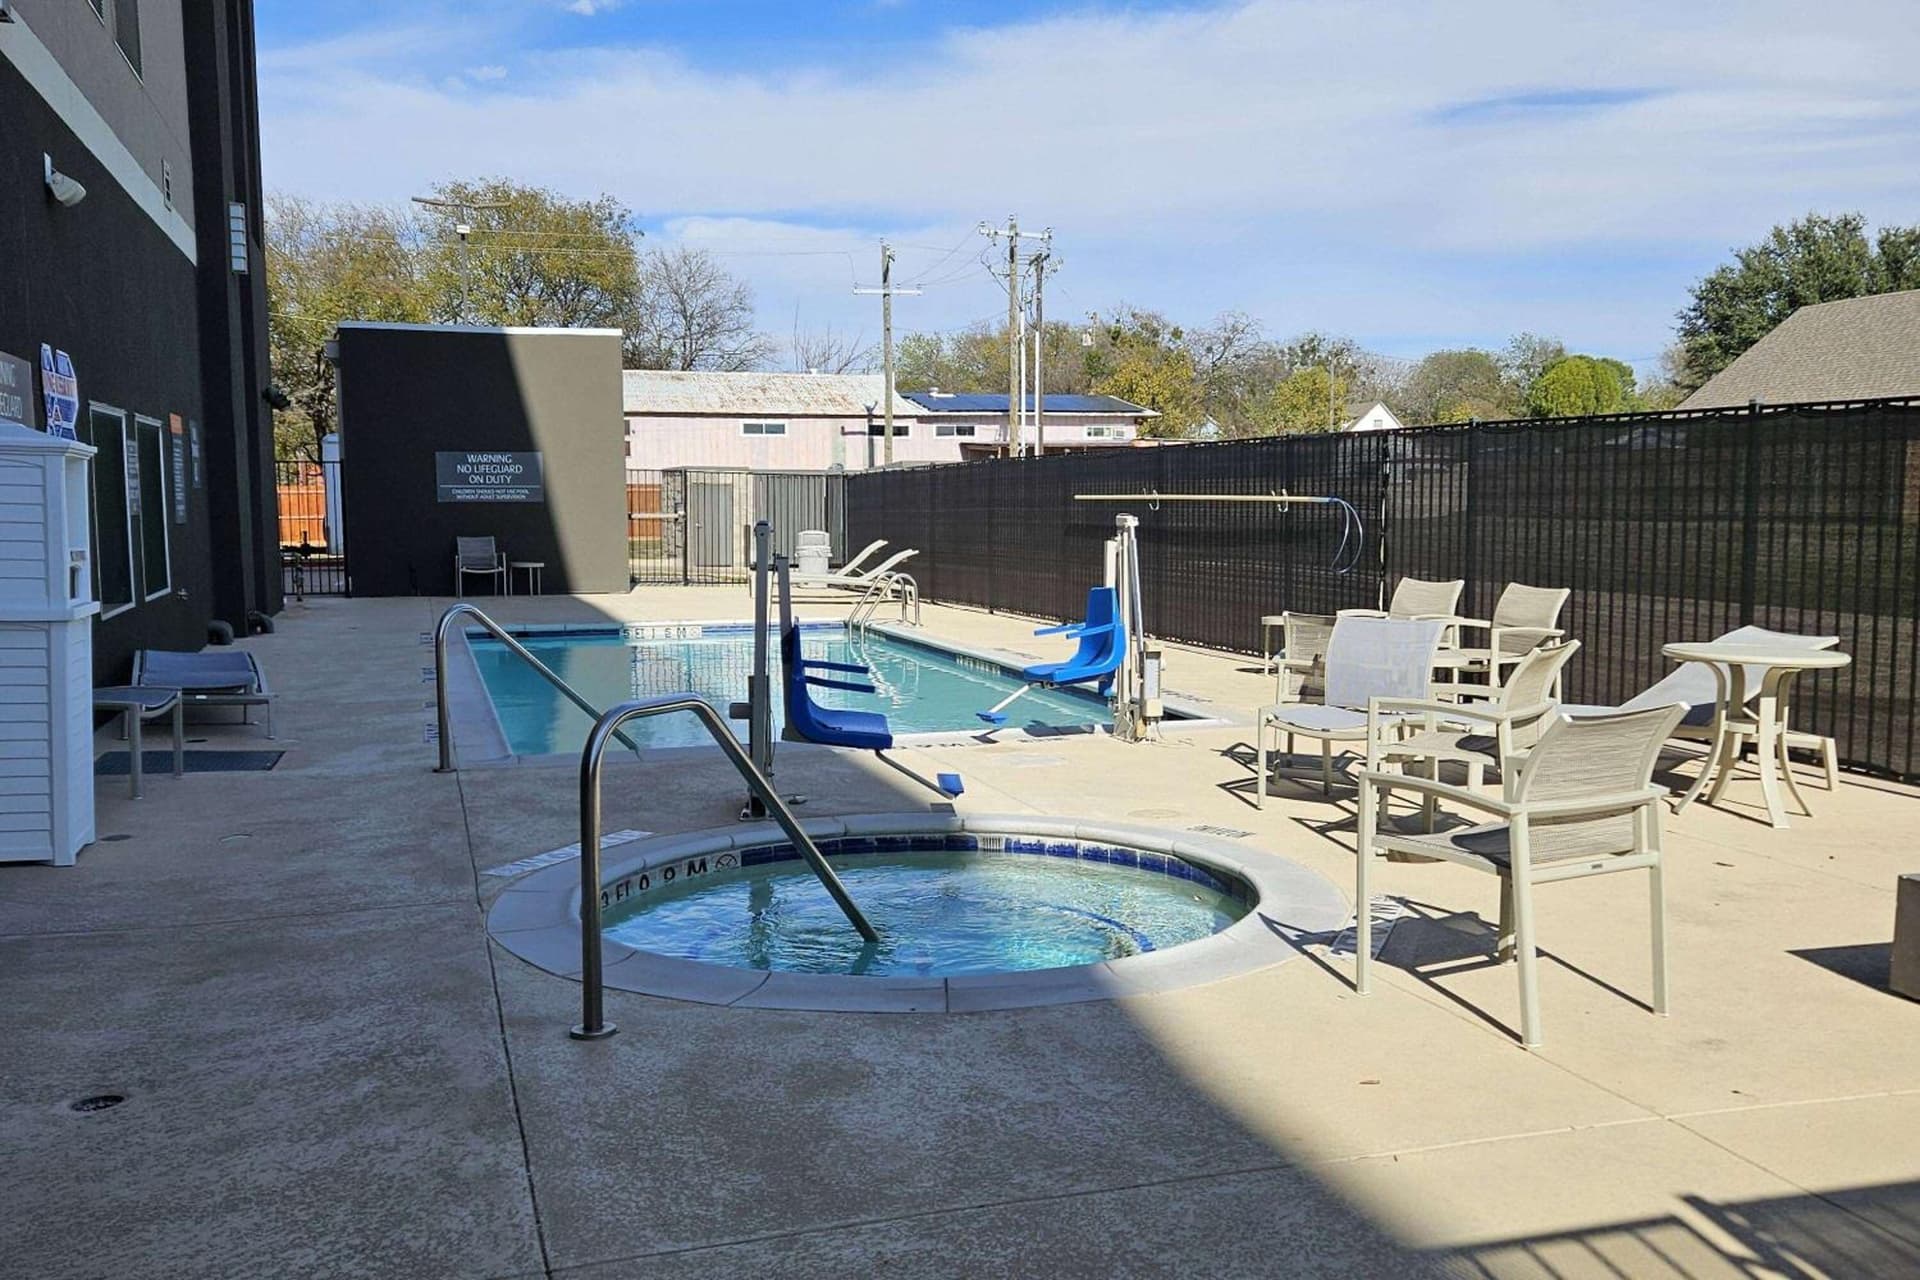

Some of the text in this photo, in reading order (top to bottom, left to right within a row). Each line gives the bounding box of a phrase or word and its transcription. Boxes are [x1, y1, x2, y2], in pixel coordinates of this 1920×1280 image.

[466, 454, 512, 463] WARNING
[456, 464, 523, 474] NO LIFEGUARD
[468, 474, 512, 484] ON DUTY
[686, 857, 709, 877] M
